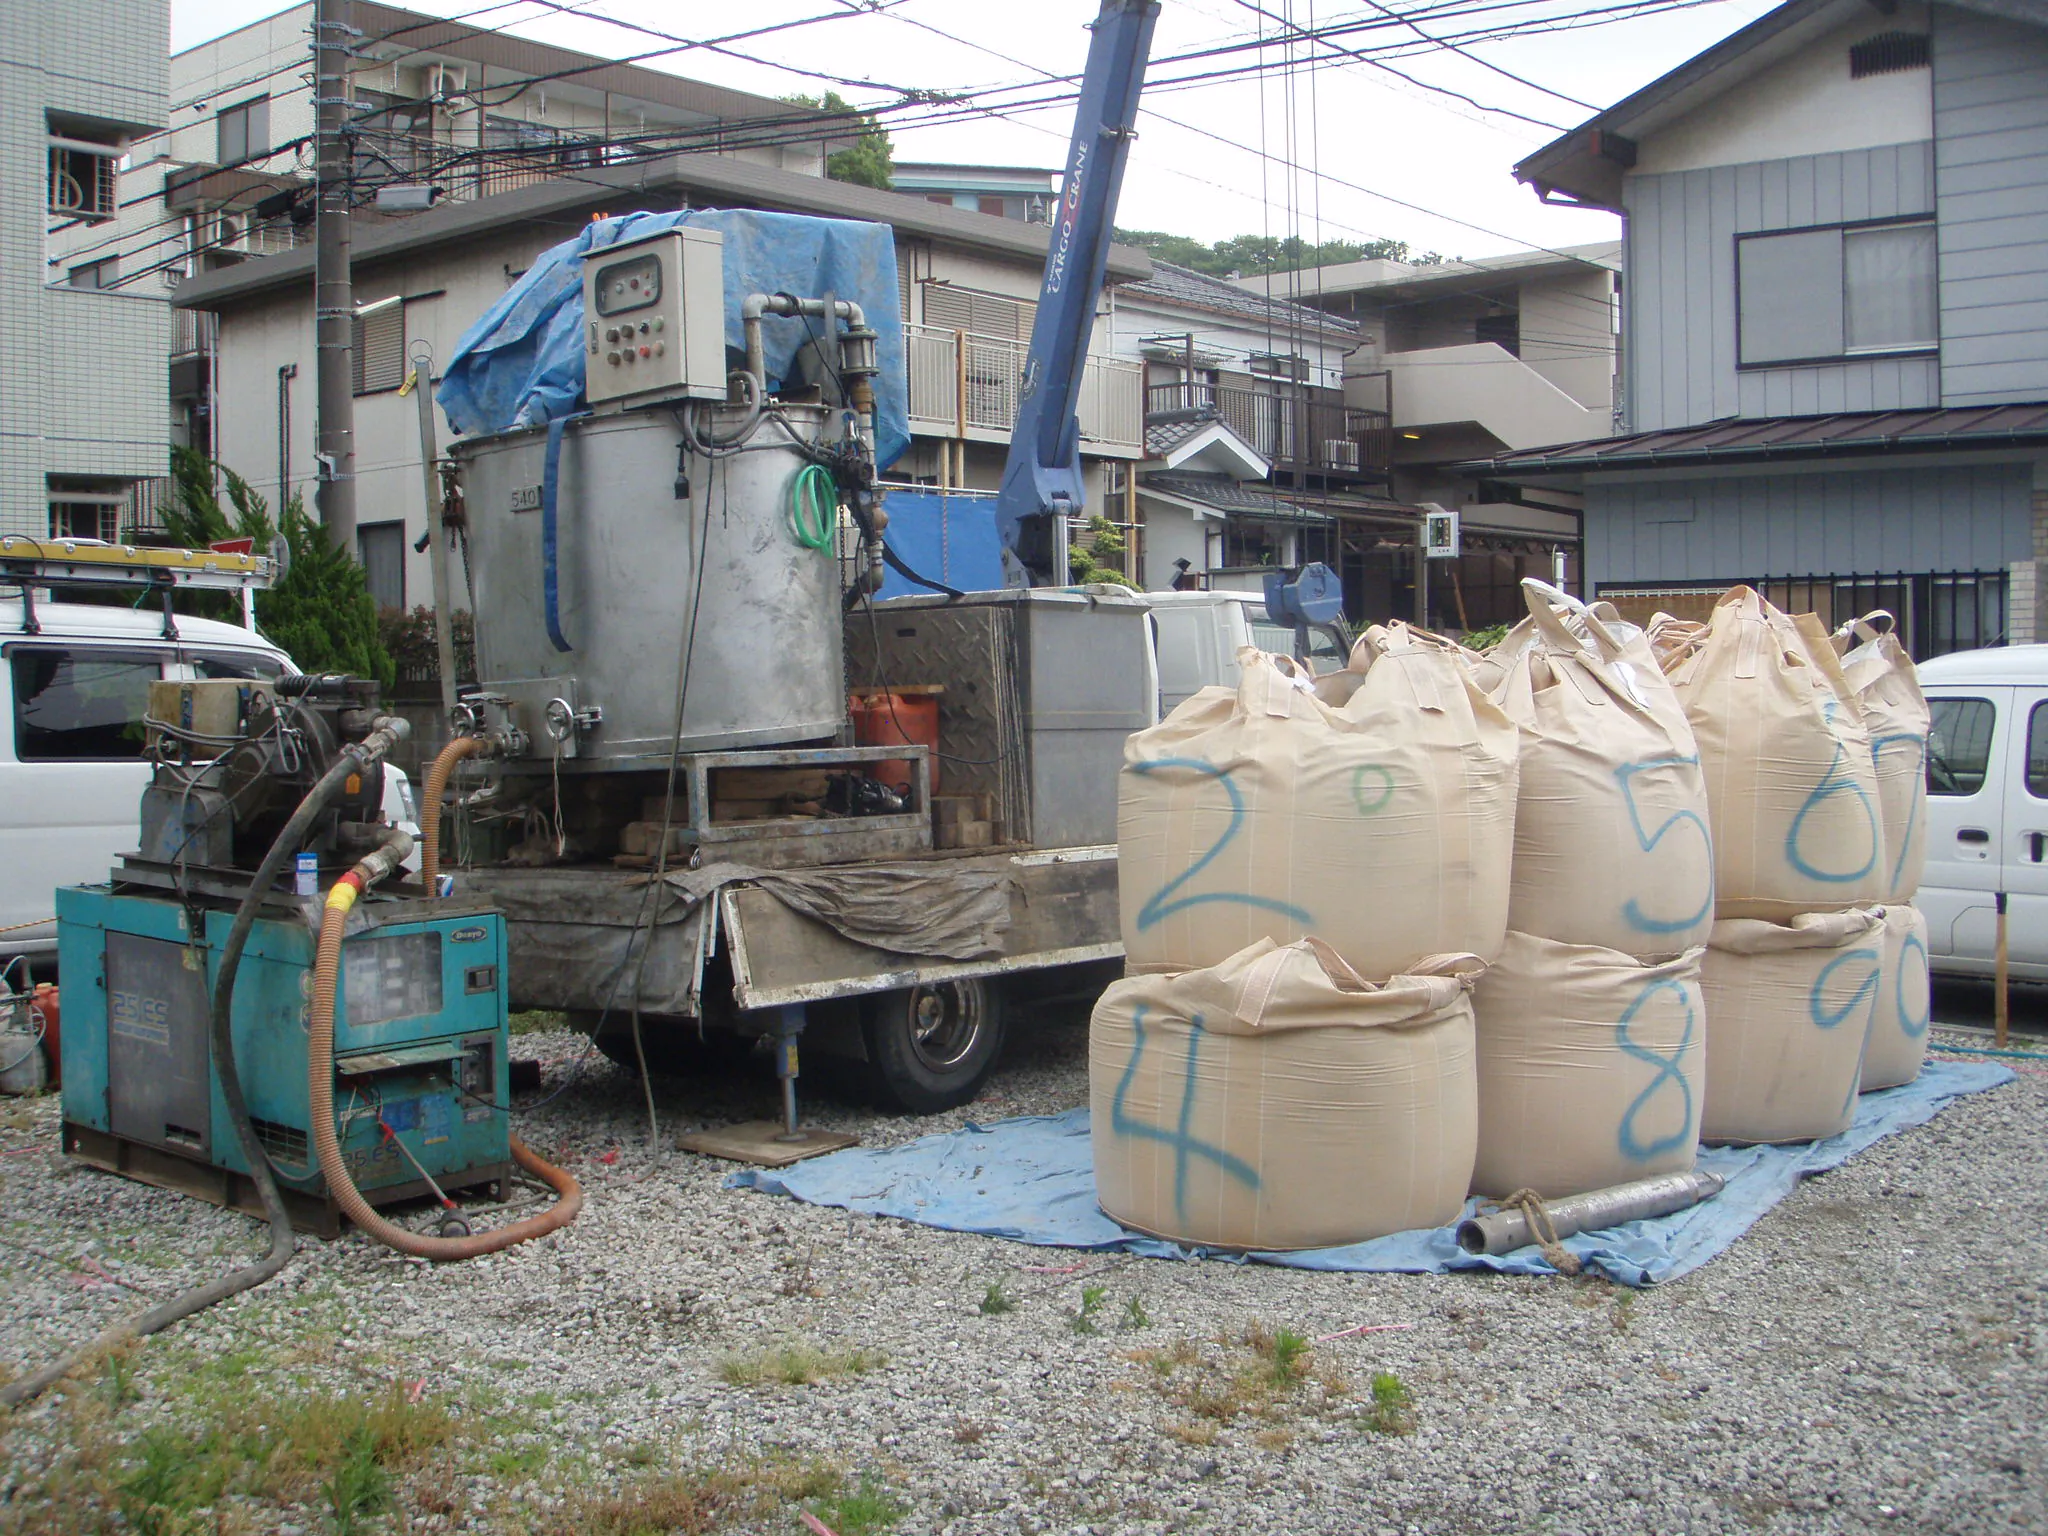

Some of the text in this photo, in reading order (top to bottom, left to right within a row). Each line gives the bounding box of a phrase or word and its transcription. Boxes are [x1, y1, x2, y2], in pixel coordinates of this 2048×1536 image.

[1052, 139, 1088, 293] CARGO CRANE
[1131, 756, 1317, 932] 2
[1613, 754, 1716, 934] 5
[1785, 692, 1879, 883] 6
[1870, 732, 1926, 897] 7
[1111, 1003, 1264, 1230] 4
[1615, 976, 1693, 1163] 8
[1809, 948, 1881, 1118] 9
